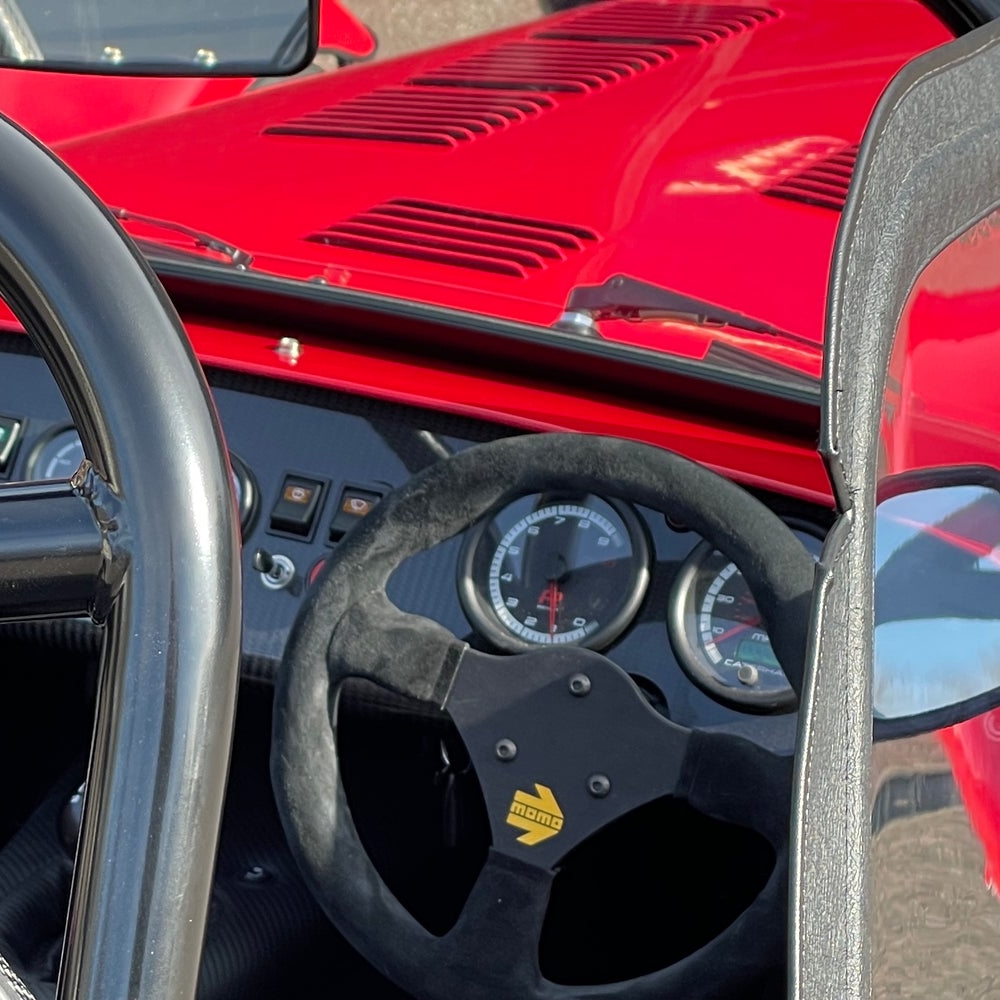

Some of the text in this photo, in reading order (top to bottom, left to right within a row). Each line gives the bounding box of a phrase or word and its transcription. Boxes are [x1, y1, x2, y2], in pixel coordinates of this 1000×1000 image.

[554, 516, 566, 525] 7
[578, 519, 591, 529] 8
[500, 573, 513, 582] 4
[524, 616, 538, 626] 2
[573, 617, 586, 627] 0
